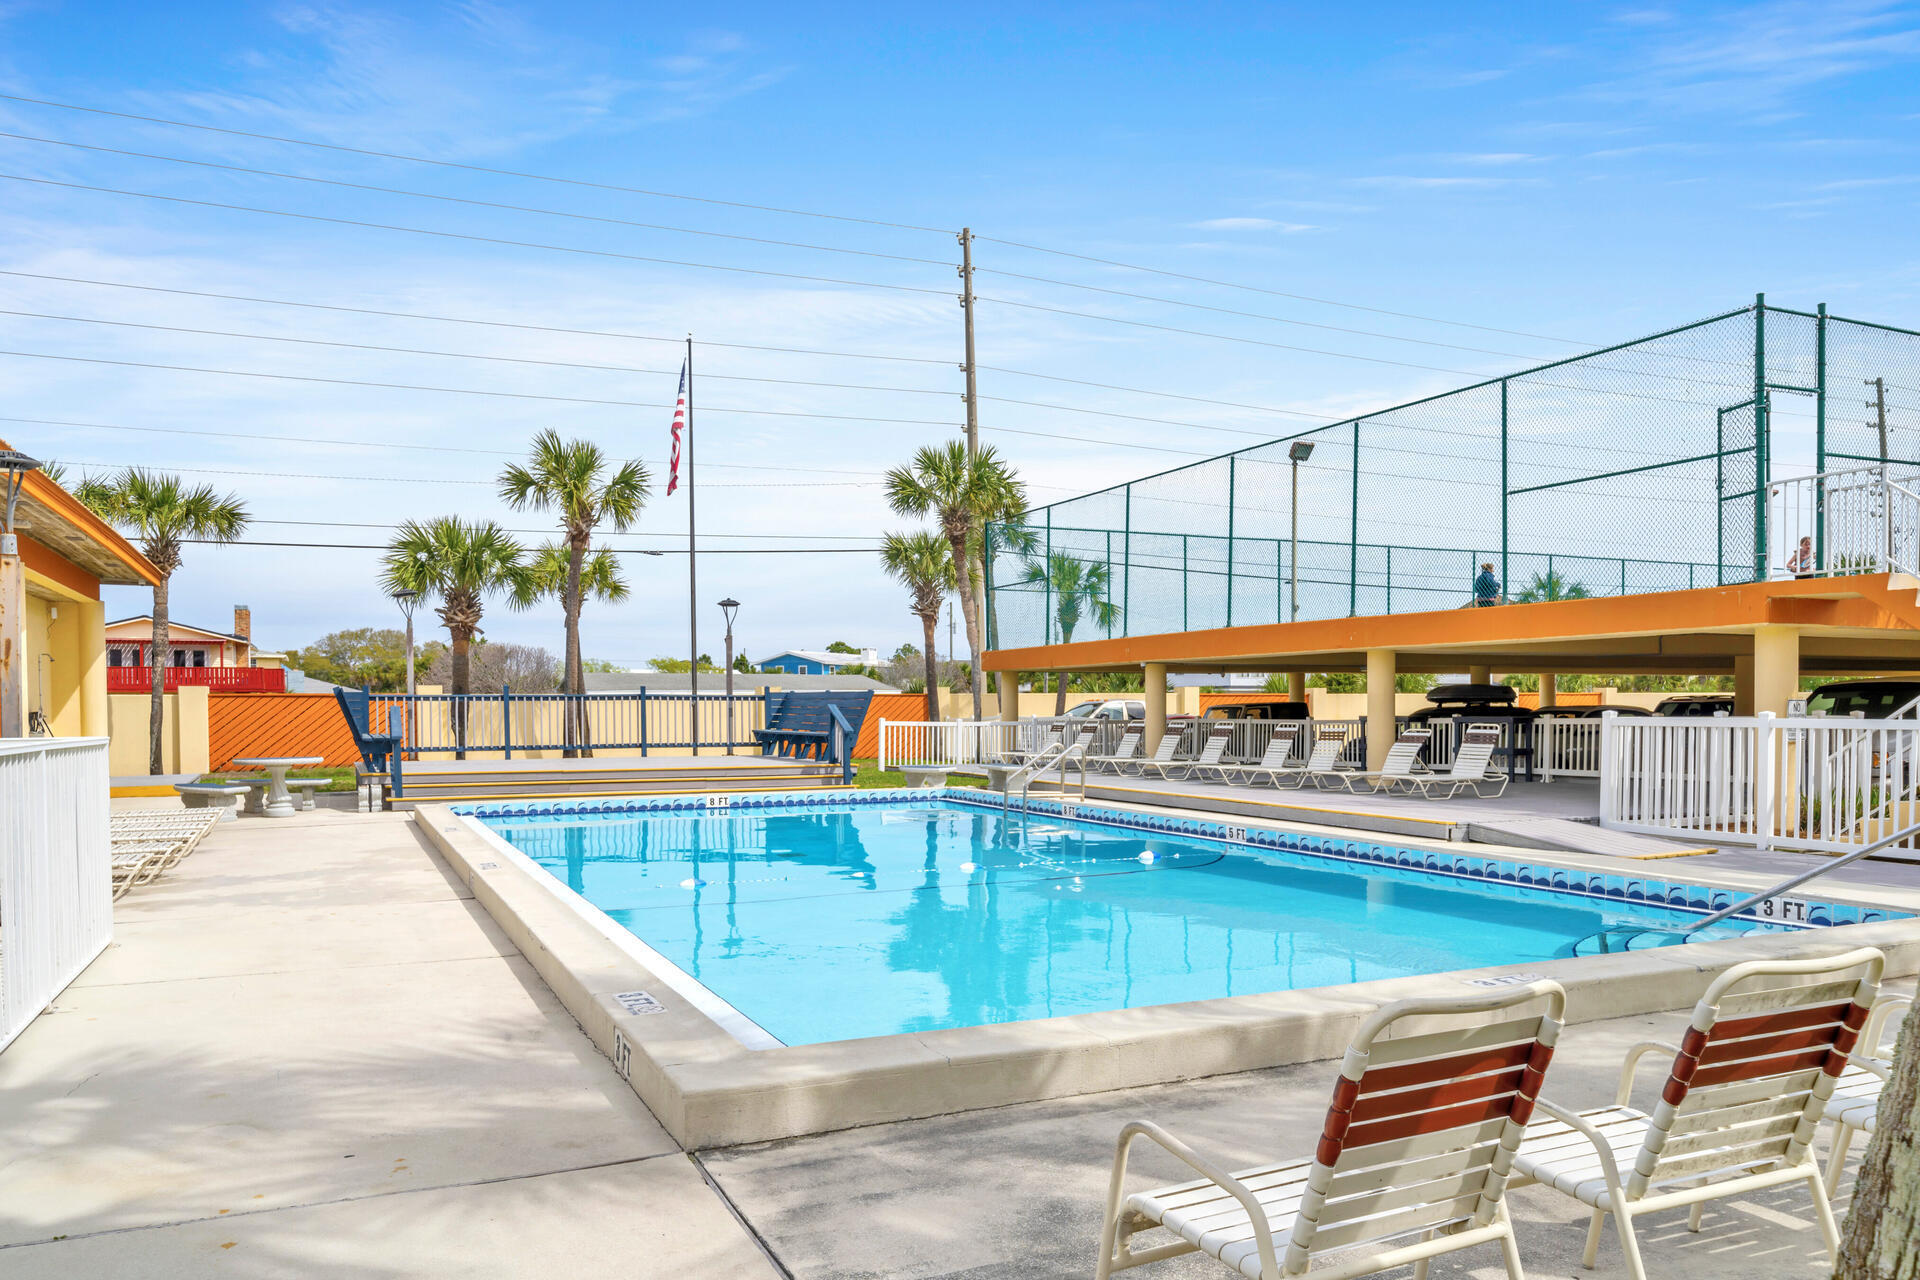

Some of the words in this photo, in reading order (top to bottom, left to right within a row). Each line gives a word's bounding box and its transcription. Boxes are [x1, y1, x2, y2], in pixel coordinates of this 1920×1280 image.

[709, 797, 715, 806] 8
[1063, 805, 1068, 815] 8
[1229, 827, 1234, 839] 5
[1763, 899, 1774, 917] 3
[1783, 900, 1805, 921] FT.
[615, 1033, 621, 1062] 3
